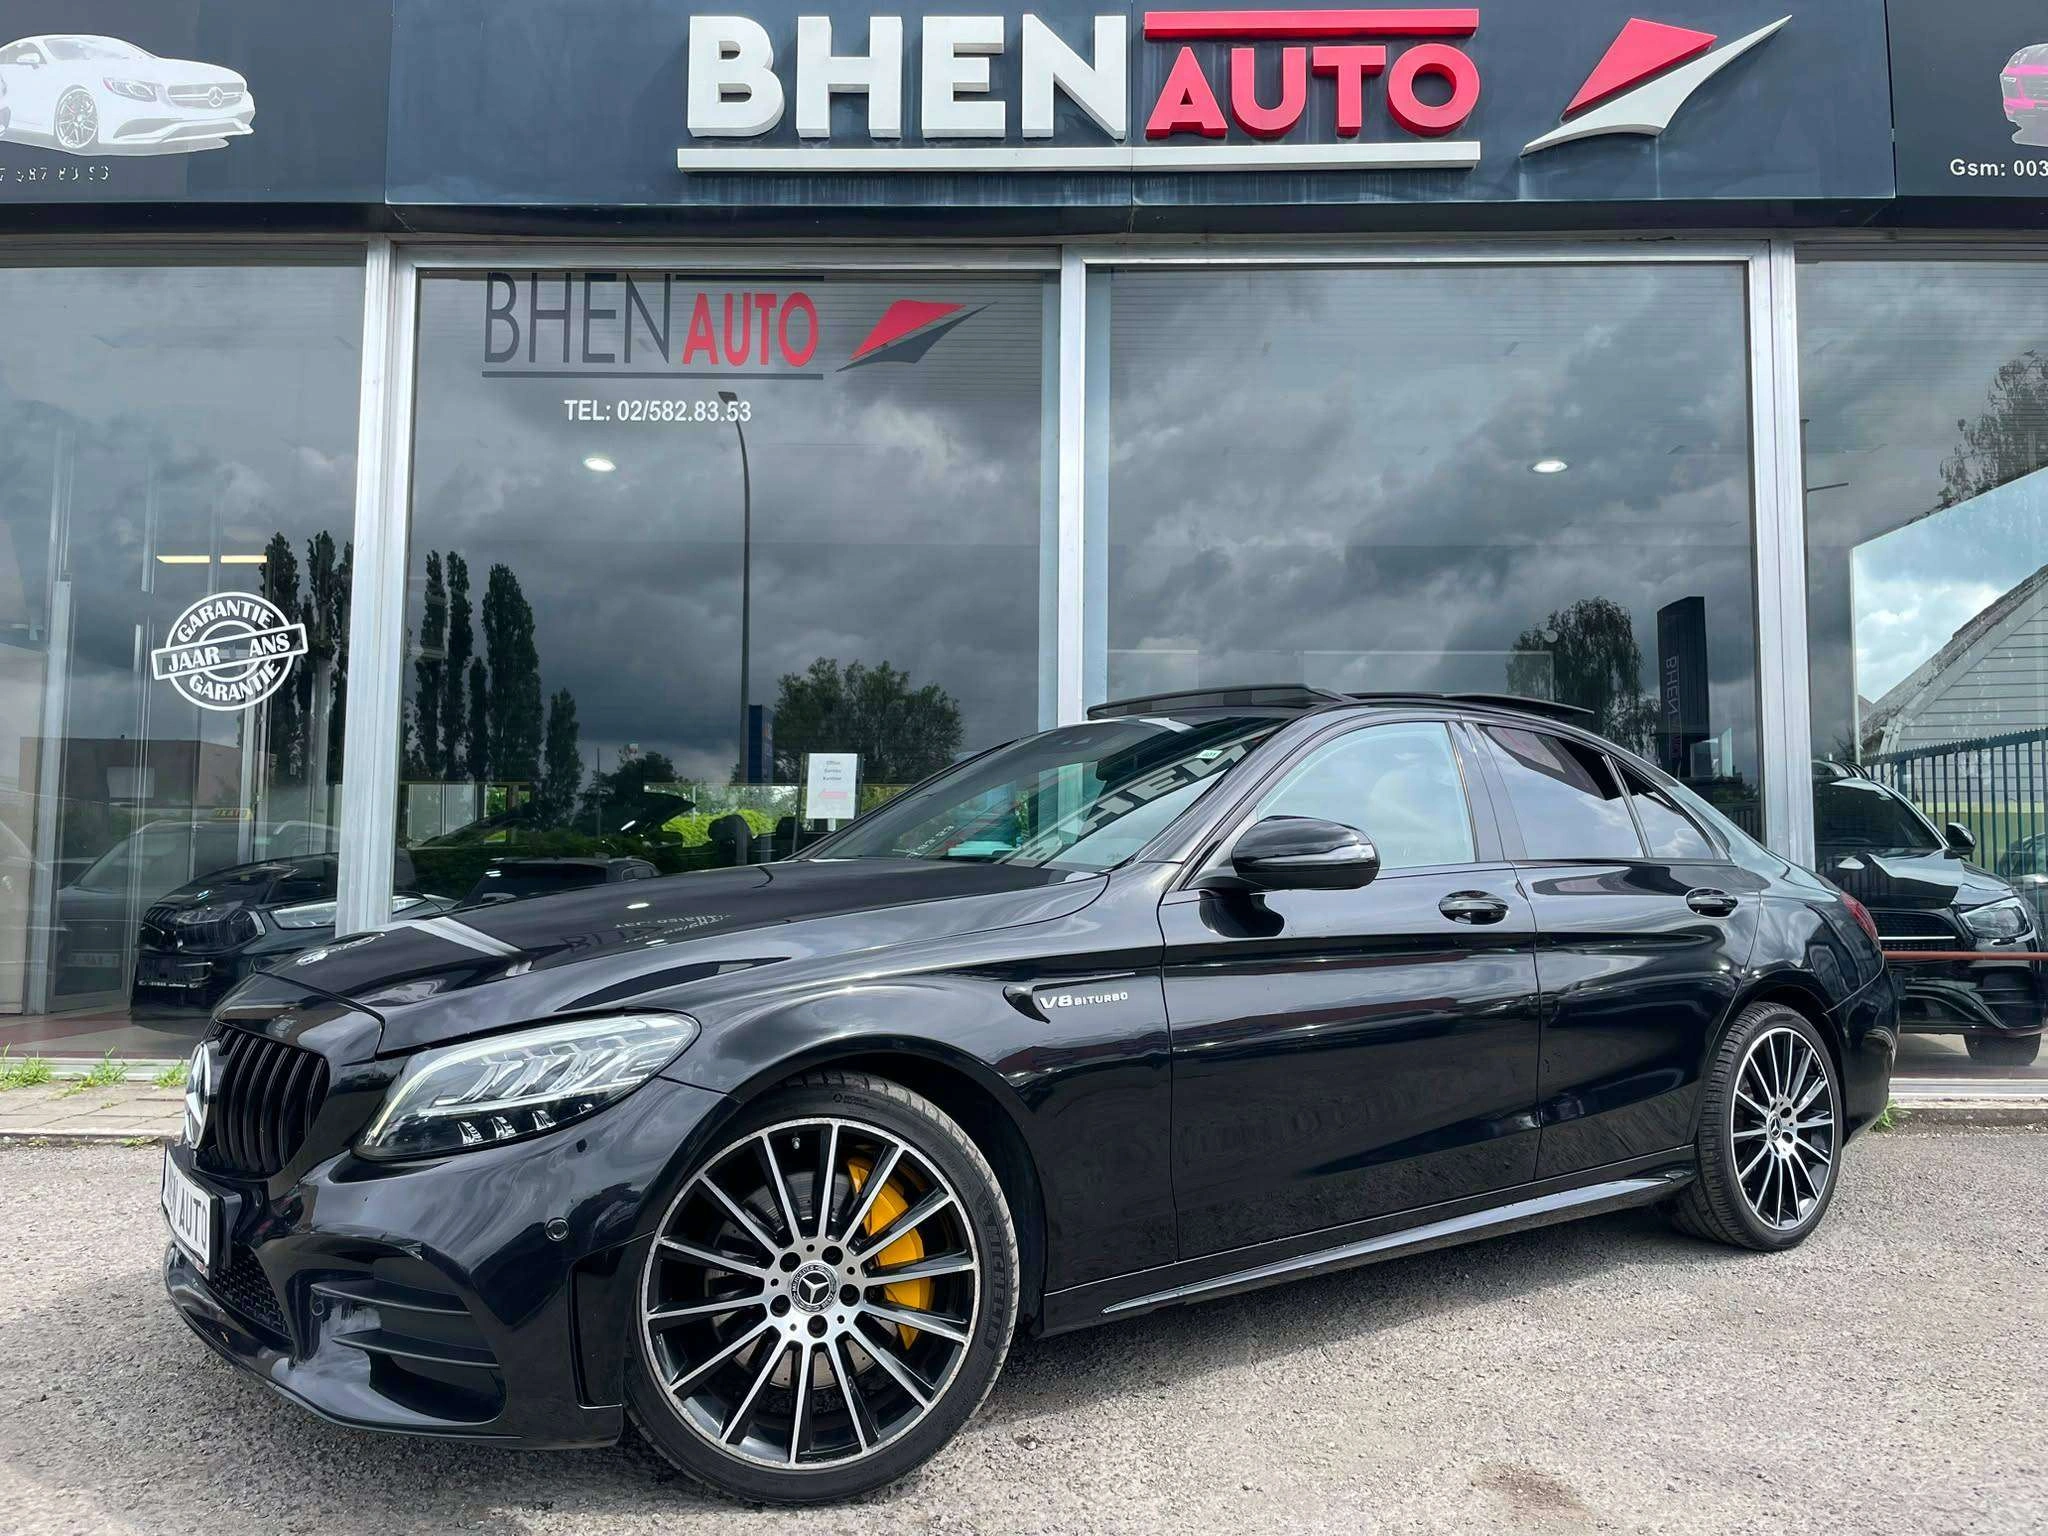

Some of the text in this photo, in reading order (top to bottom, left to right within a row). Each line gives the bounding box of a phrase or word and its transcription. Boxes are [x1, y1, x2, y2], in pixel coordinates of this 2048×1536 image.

[686, 15, 1481, 140] BHEN AUTO
[1949, 158, 2006, 177] Gsm:
[483, 271, 819, 367] BHEN AUTO
[564, 400, 752, 422] TEL: 02/582.83.53
[177, 599, 274, 643] GARANTIE
[168, 633, 291, 673] JAAR ANS
[189, 660, 281, 701] GARANTIE
[1040, 992, 1129, 1009] V8 BITURBO
[180, 1187, 207, 1248] AUTO
